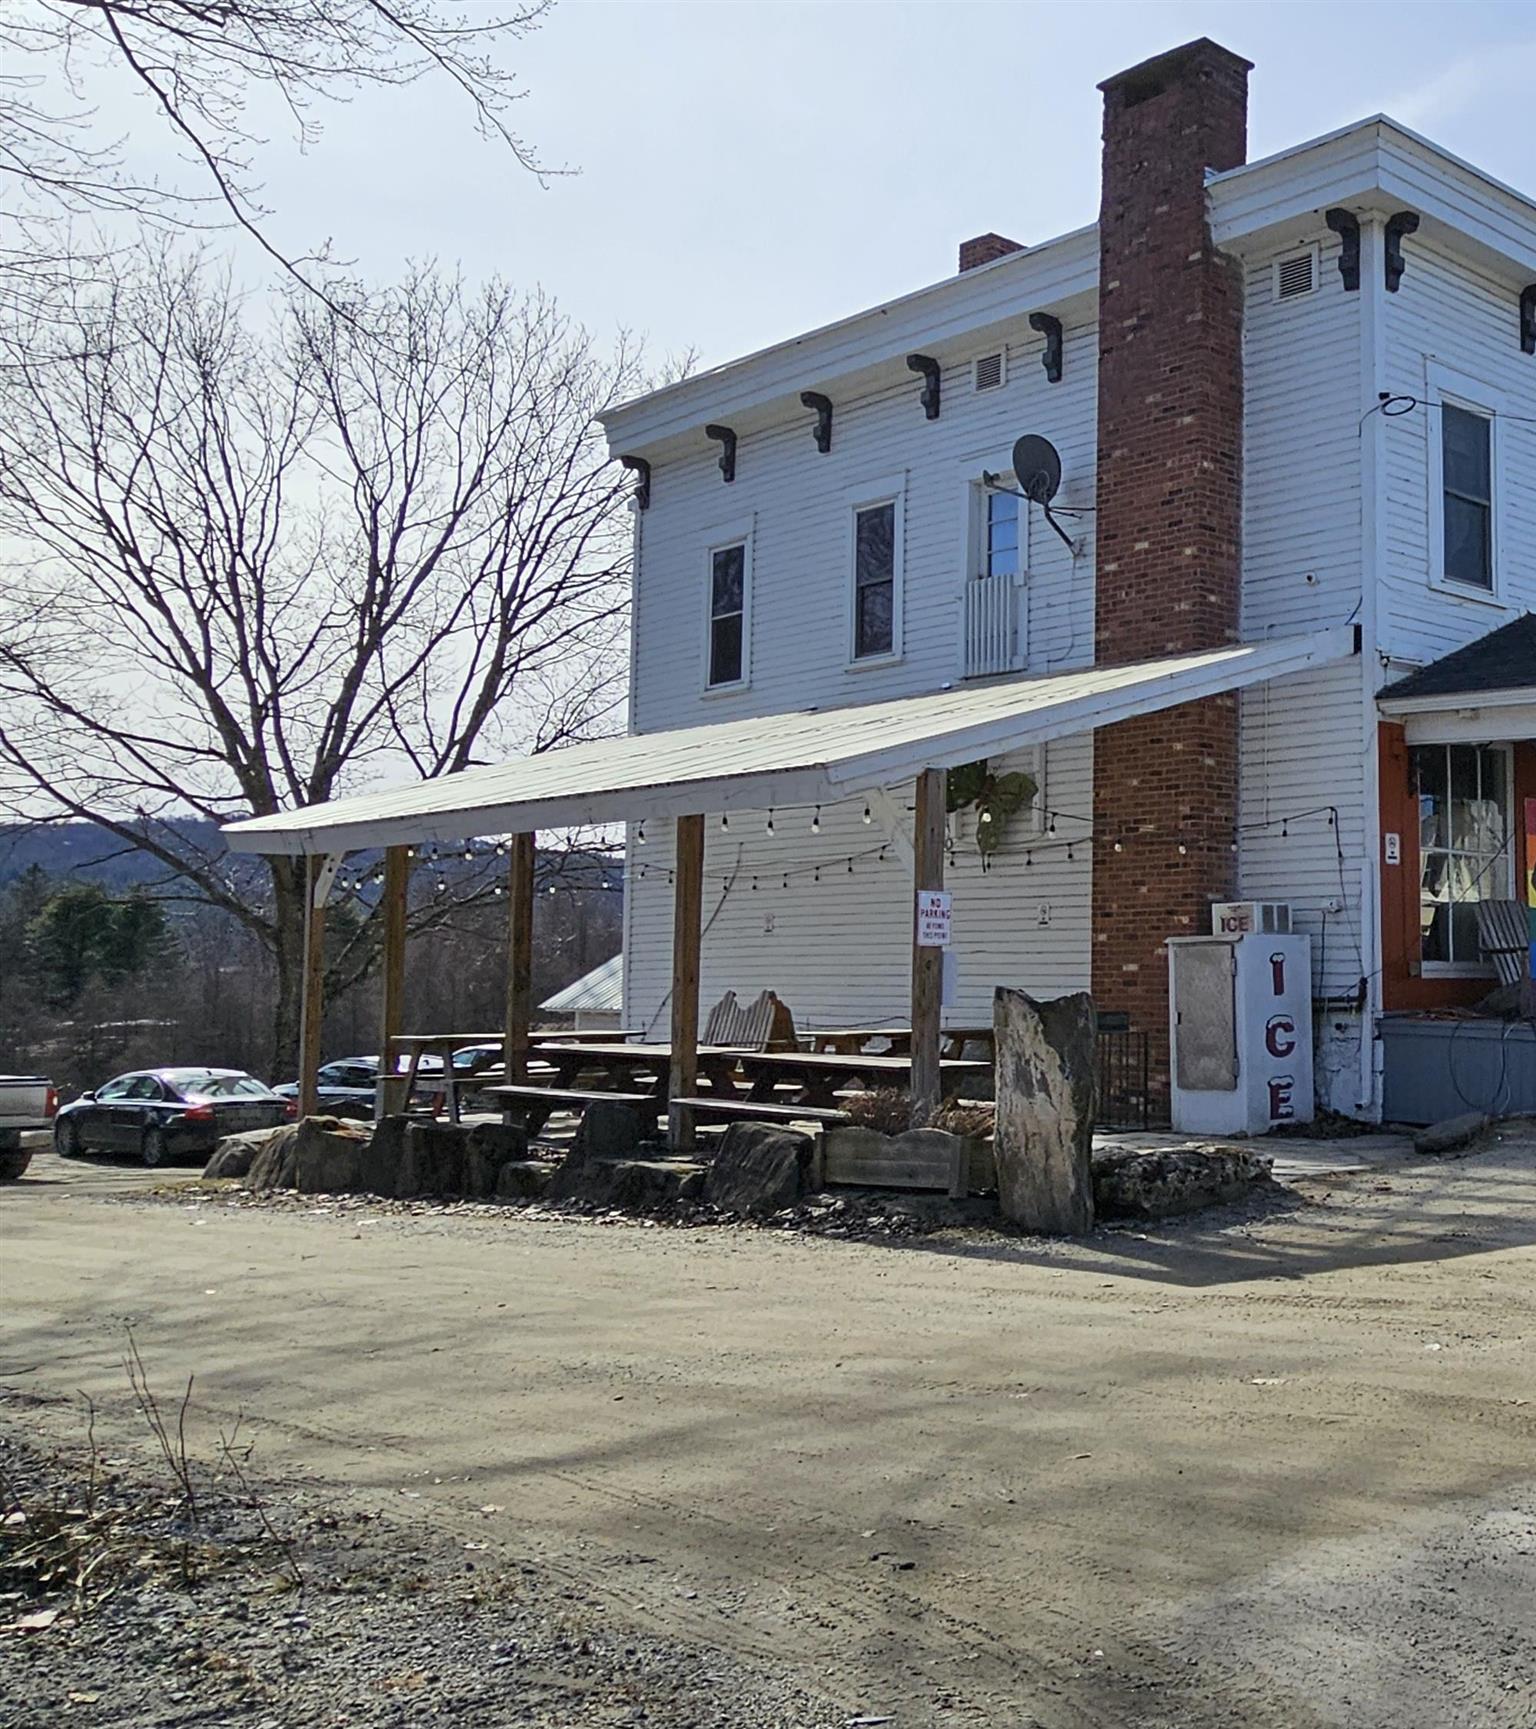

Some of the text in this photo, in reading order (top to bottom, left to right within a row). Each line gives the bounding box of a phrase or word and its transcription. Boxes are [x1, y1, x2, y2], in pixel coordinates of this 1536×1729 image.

[930, 897, 942, 908] NO
[920, 908, 951, 920] PARKING
[1220, 916, 1249, 933] ICE
[1265, 952, 1296, 1120] ICE
